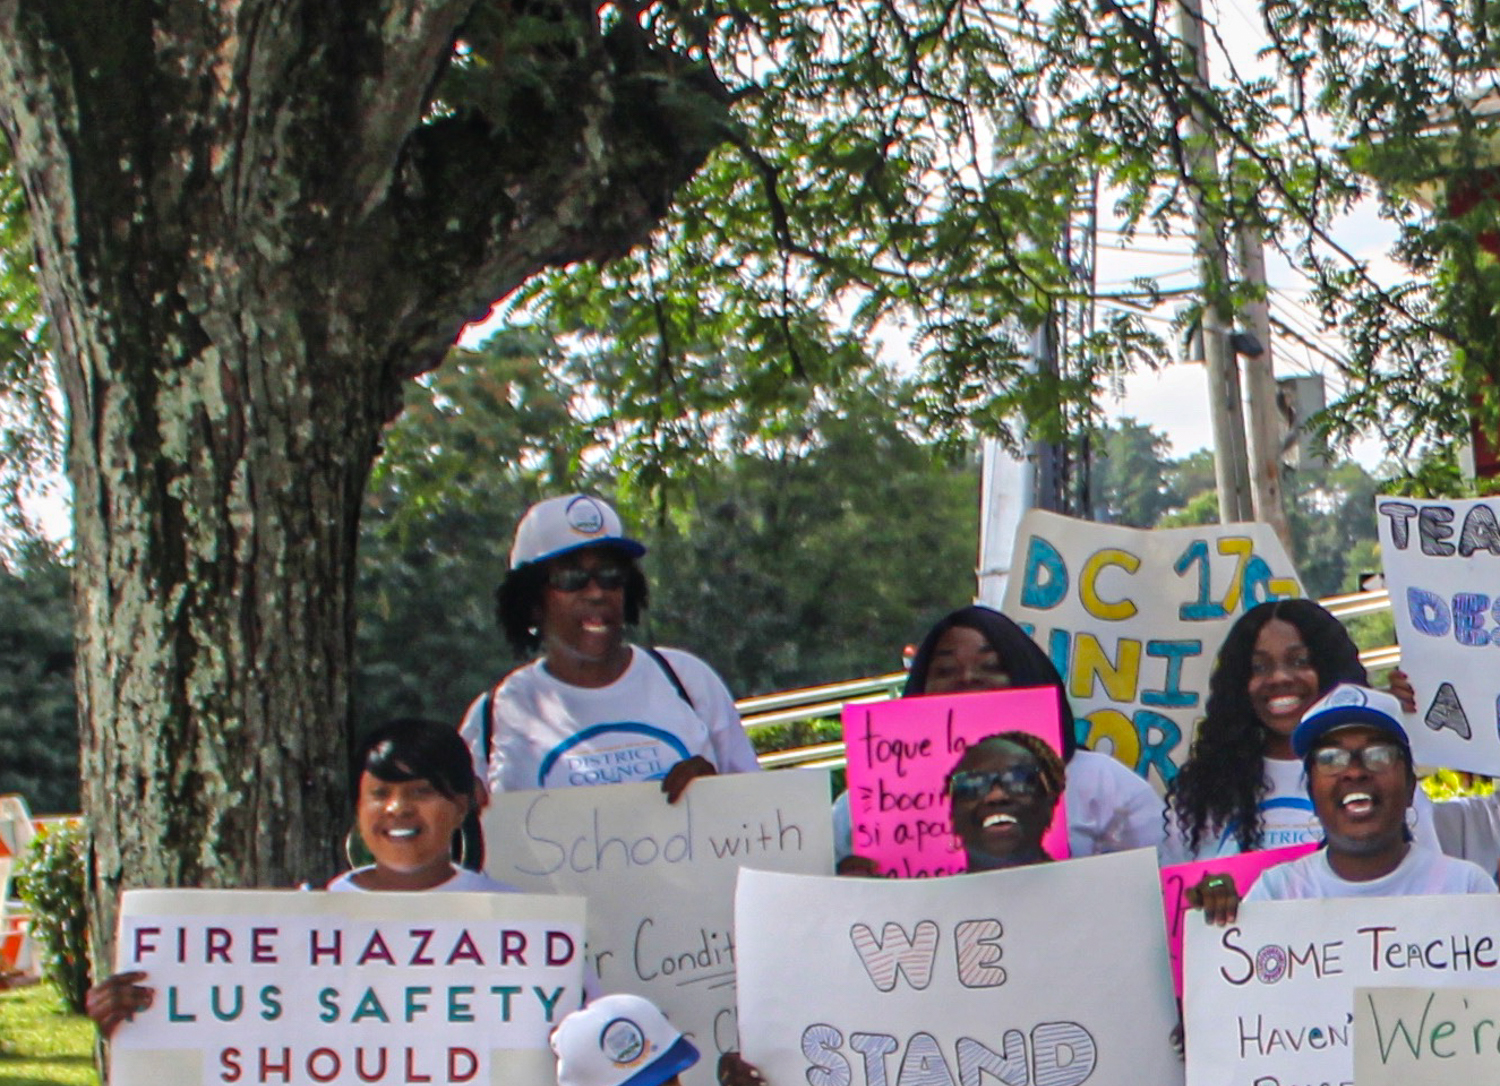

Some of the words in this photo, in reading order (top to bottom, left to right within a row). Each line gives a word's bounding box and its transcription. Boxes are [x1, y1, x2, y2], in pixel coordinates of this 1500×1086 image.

[1020, 534, 1141, 621] DC
[1424, 681, 1473, 741] A
[566, 748, 660, 770] DISTRICT
[859, 710, 931, 776] toque
[709, 809, 802, 859] with
[858, 824, 880, 847] si
[132, 927, 279, 965] FIRE
[309, 928, 576, 966] HAZARD
[849, 918, 1008, 993] WE
[126, 985, 284, 1022] LUS
[319, 986, 566, 1023] SAFETY
[219, 1046, 480, 1083] SHOULD
